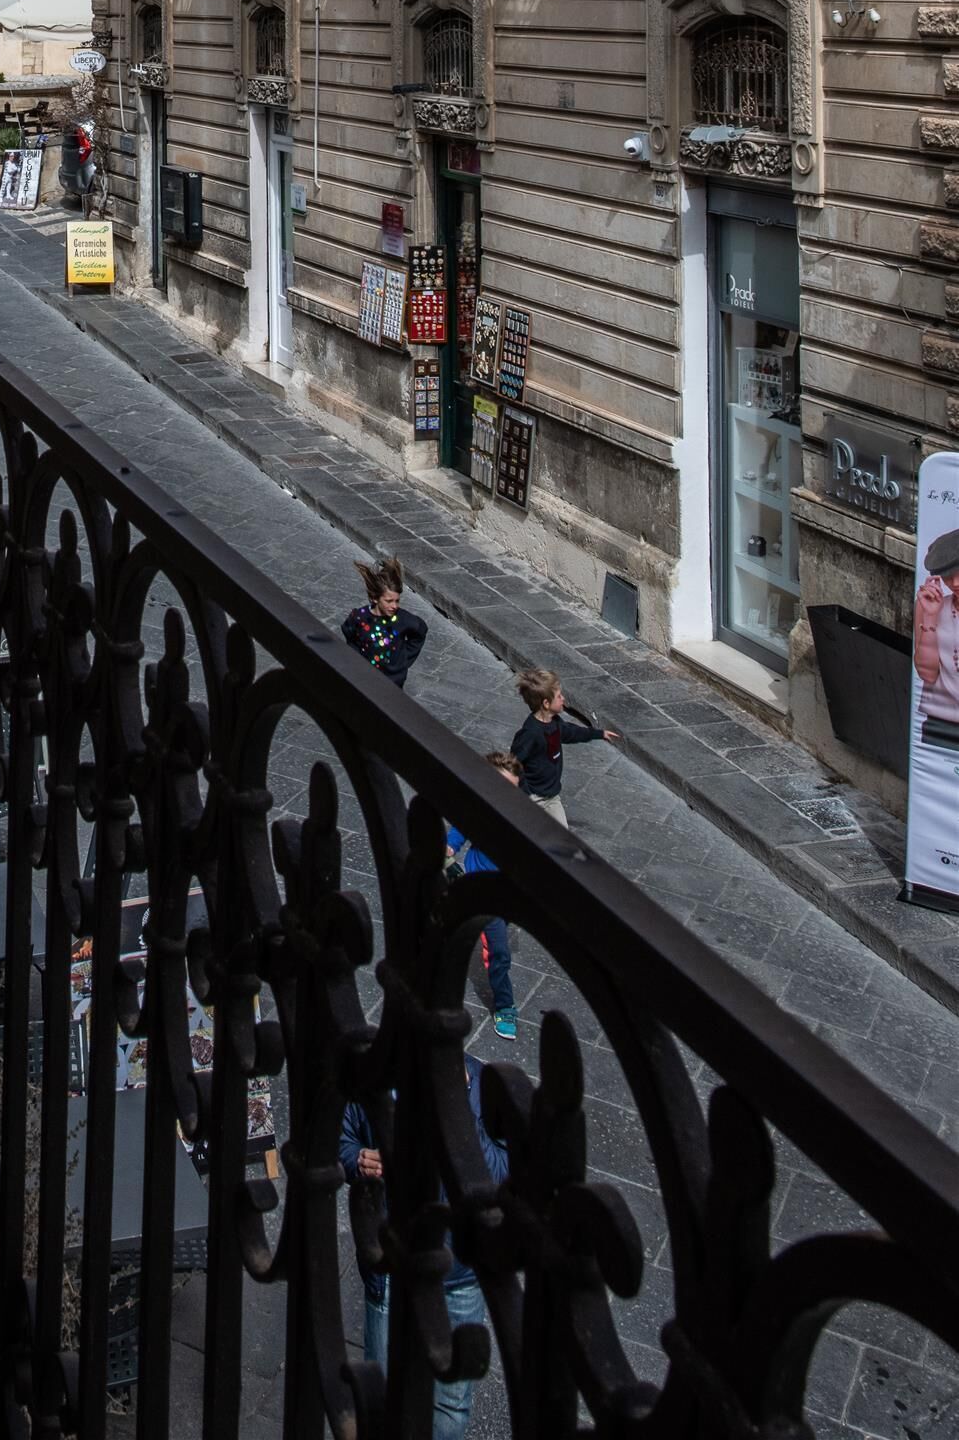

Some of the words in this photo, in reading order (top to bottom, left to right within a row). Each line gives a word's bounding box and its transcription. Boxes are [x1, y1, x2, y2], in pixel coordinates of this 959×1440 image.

[74, 56, 102, 64] LIBERTY
[73, 238, 107, 248] Ceramiche
[74, 248, 107, 258] Artistiche
[73, 261, 107, 269] Sicilian
[75, 270, 107, 279] Pottery
[833, 438, 900, 500] Prado
